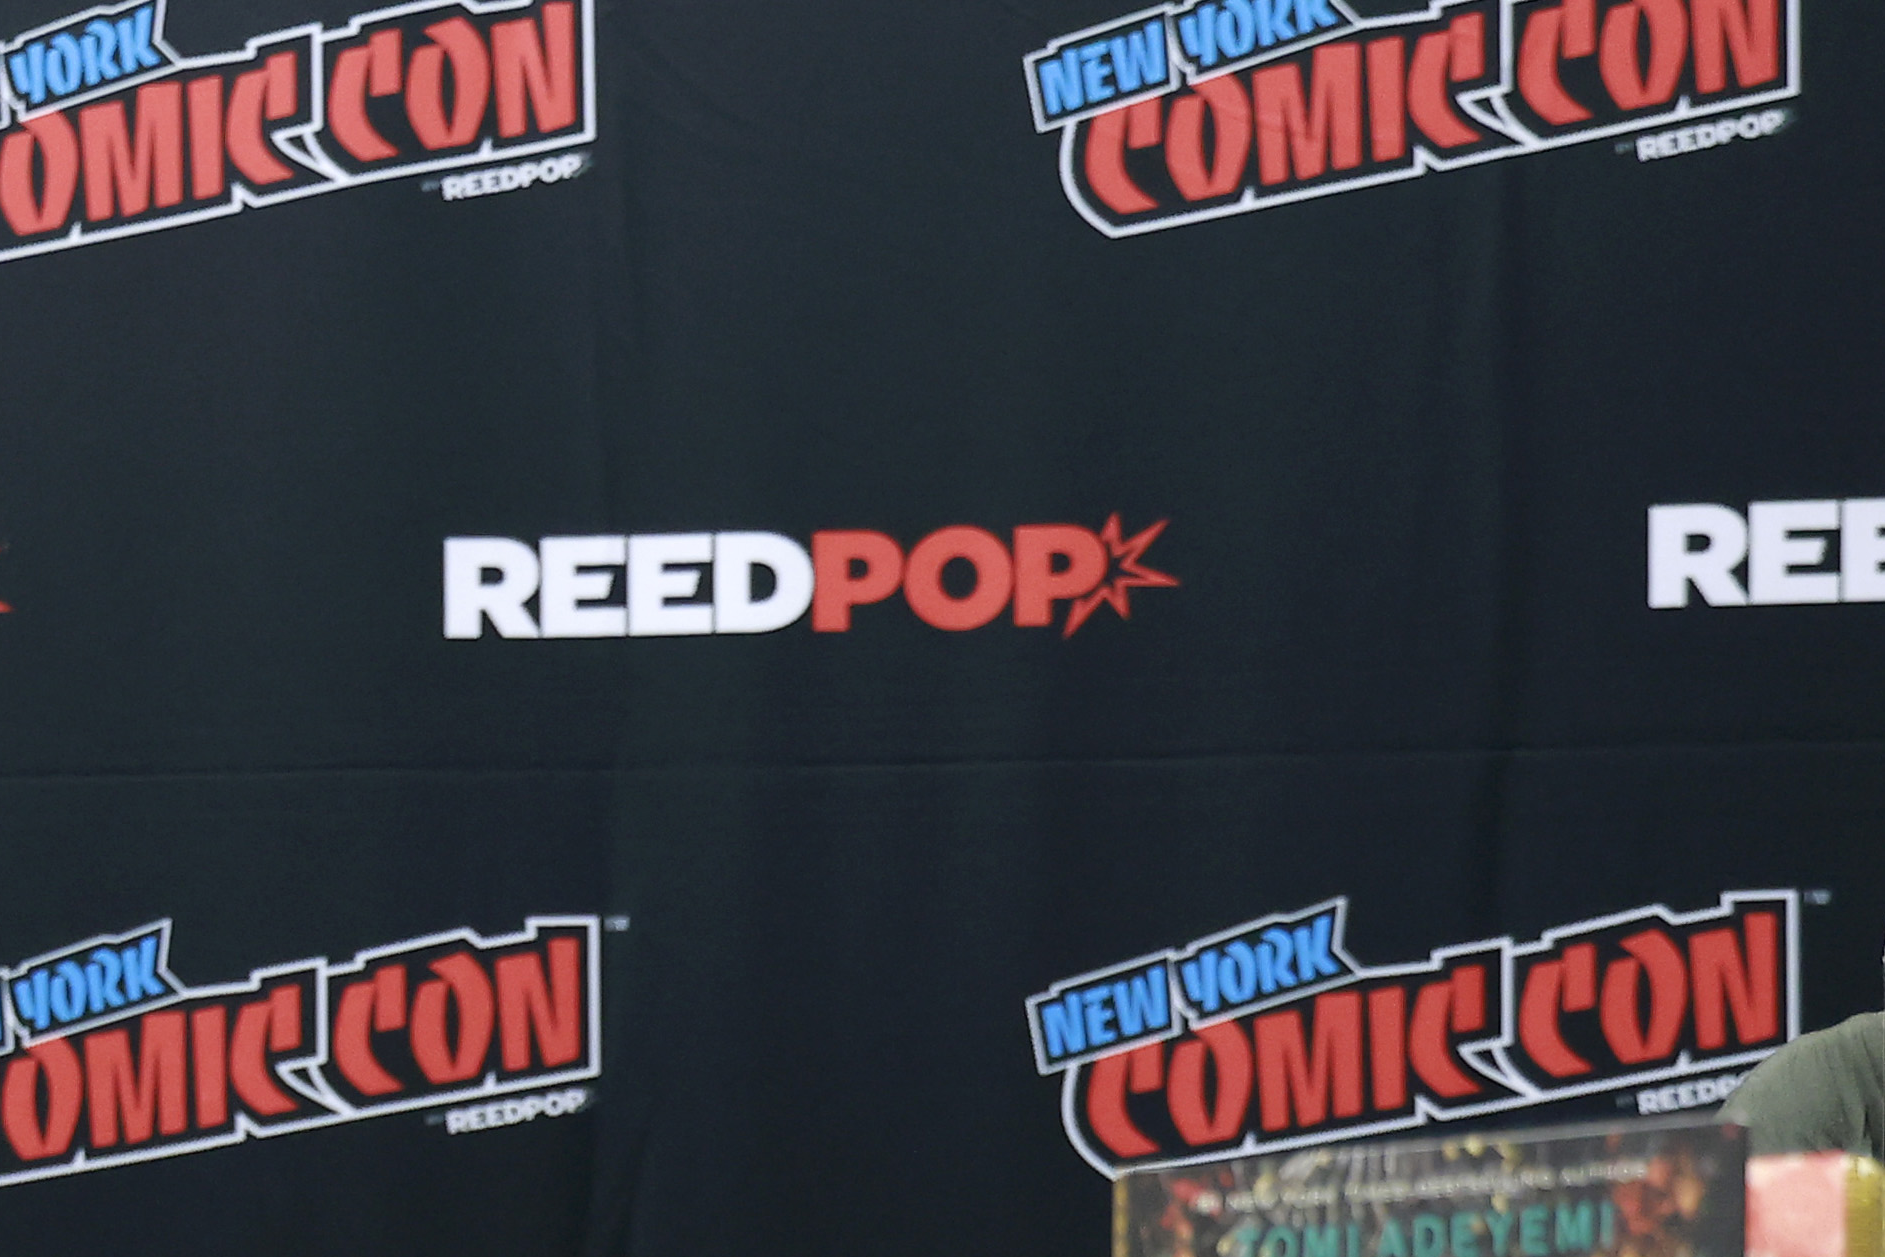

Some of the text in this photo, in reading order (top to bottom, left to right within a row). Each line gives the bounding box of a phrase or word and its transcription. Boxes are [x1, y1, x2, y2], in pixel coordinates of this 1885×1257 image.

[10, 6, 161, 104] YORK
[327, 2, 577, 162] CON
[1039, 20, 1167, 115] NEW
[1085, 0, 1779, 215] COMIC CON
[442, 156, 582, 201] REEDPOP
[1638, 110, 1782, 162] REEDPOP
[444, 524, 1107, 639] REEDPOP
[15, 936, 165, 1030] YORK
[333, 937, 581, 1096] CON
[1041, 915, 1339, 1057] NEW YORK
[1087, 911, 1779, 1158] COMIC CON
[446, 1090, 586, 1135] REEDPOP
